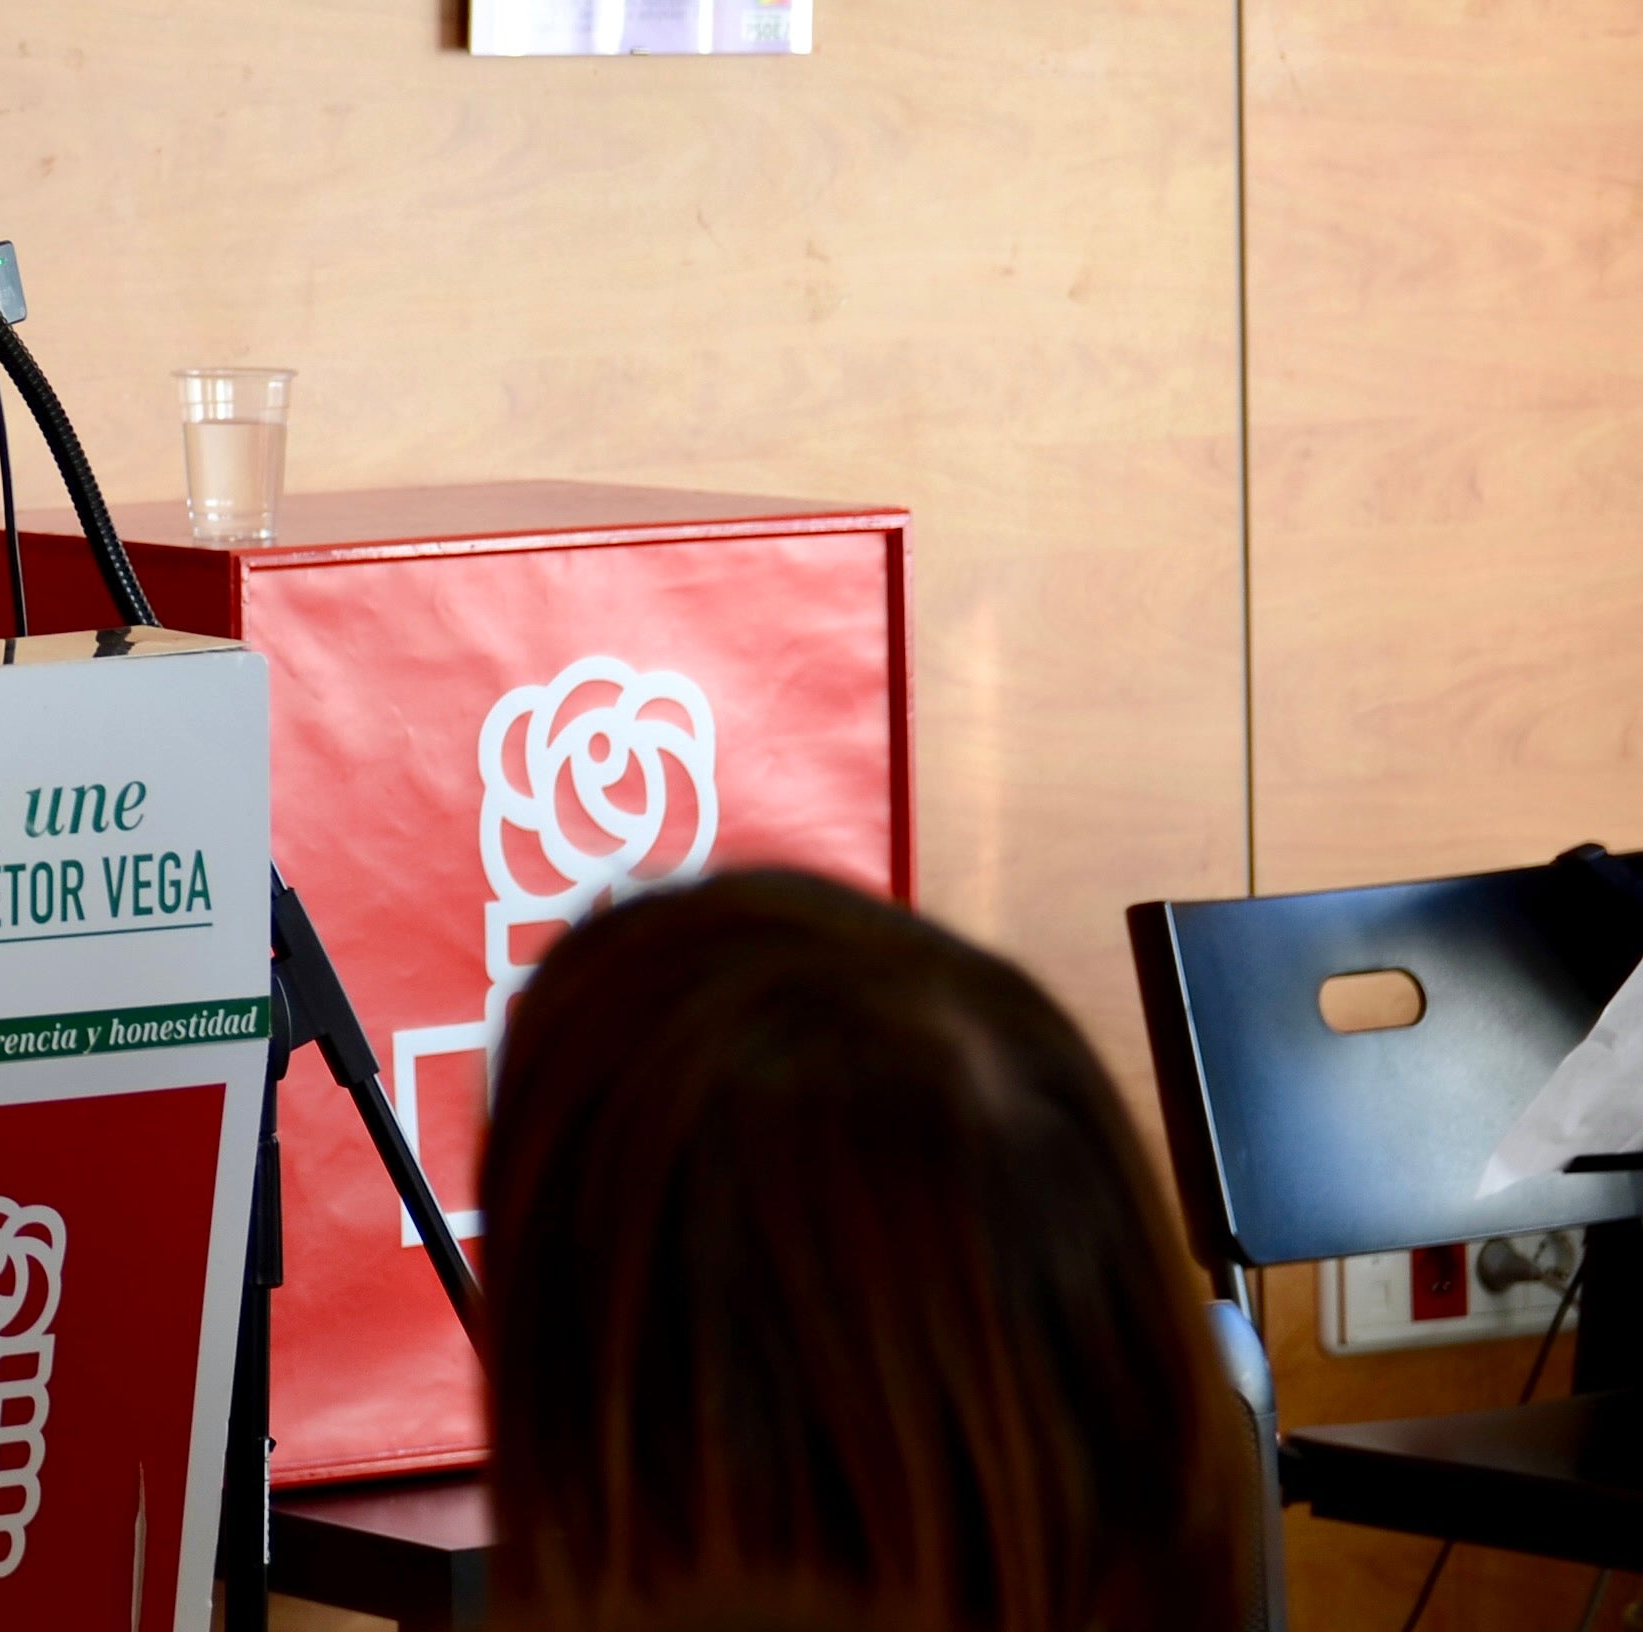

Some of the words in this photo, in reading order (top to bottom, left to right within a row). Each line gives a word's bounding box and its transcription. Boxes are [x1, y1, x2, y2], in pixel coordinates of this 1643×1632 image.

[24, 780, 147, 838] une
[102, 849, 213, 918] VEGA
[82, 1024, 102, 1054] y
[109, 1006, 258, 1045] honestidad
